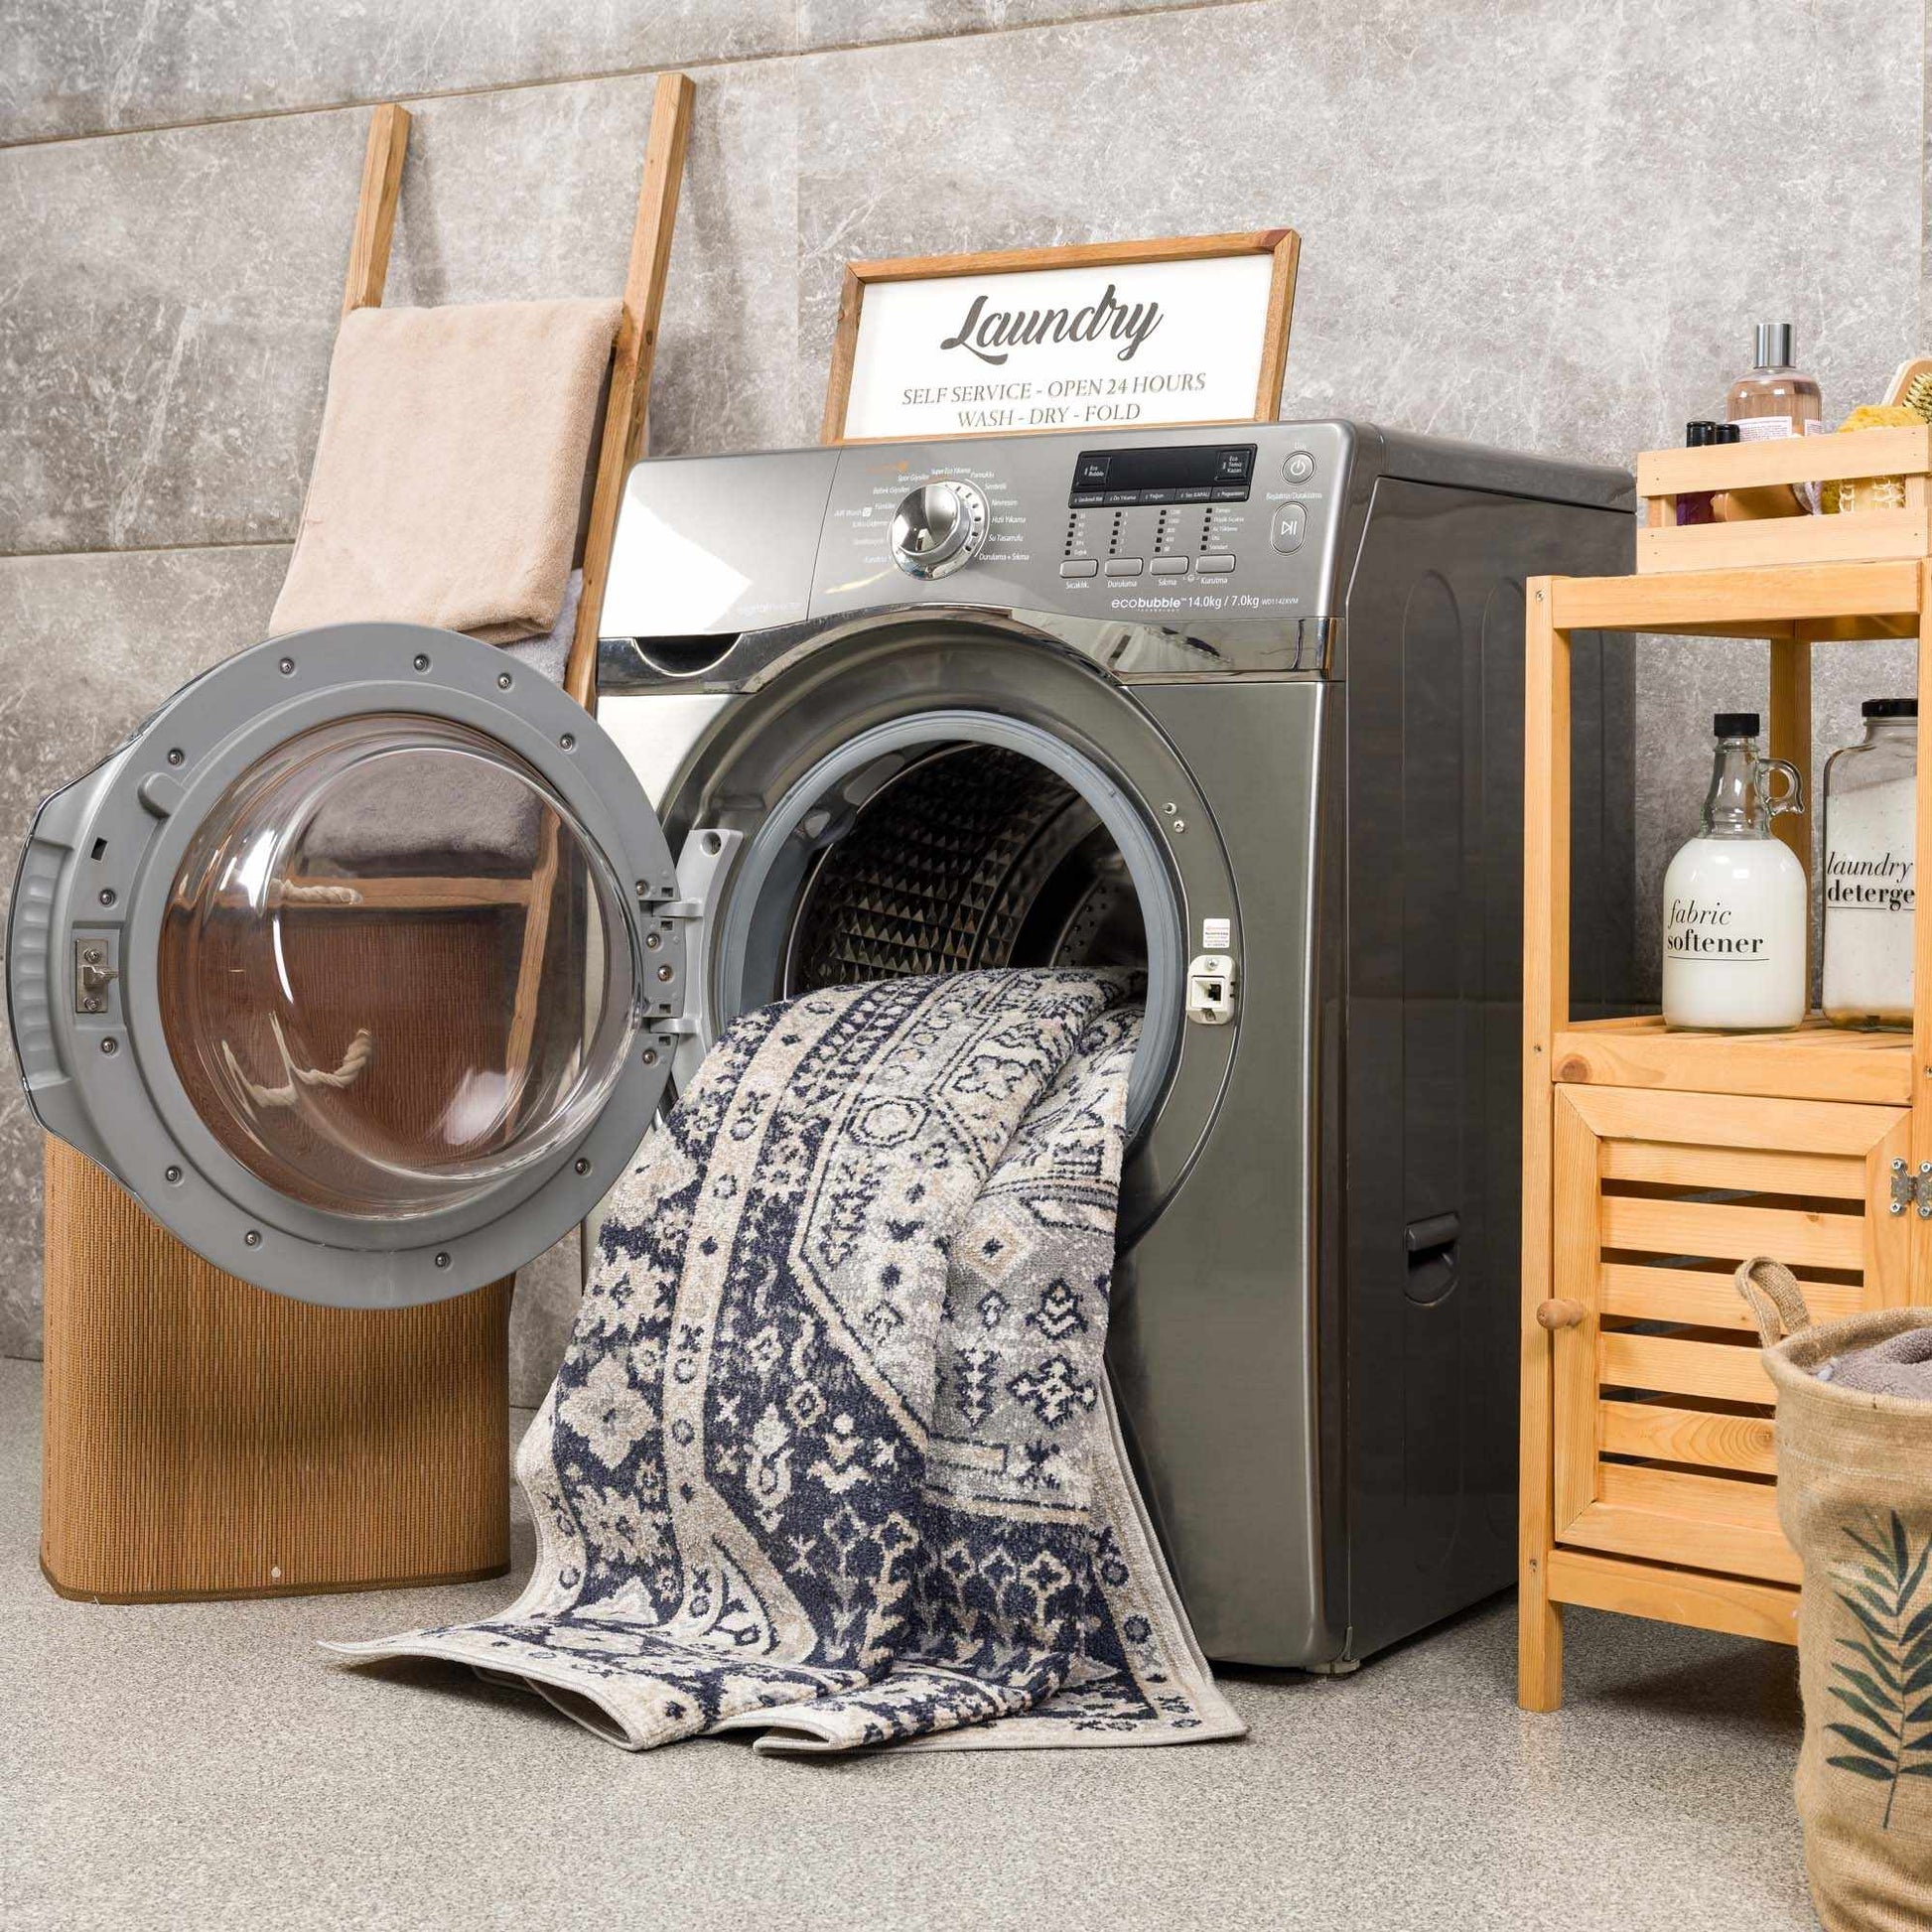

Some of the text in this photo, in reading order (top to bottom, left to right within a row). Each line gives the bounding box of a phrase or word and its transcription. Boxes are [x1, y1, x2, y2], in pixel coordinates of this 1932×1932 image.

[940, 284, 1164, 365] Laundry
[902, 387, 949, 405] SELF
[953, 382, 1032, 403] SERVICE
[1047, 378, 1102, 399] OPEN
[1106, 377, 1129, 396] 24
[1133, 372, 1206, 394] HOURS
[957, 408, 1014, 428] WASH
[1030, 406, 1070, 425] DRY
[1085, 402, 1141, 423] FOLD
[1188, 596, 1222, 610] 14.0kg
[1231, 595, 1260, 609] 7.0kg
[1827, 851, 1914, 884] laundry
[1668, 898, 1731, 929] fabric
[1667, 929, 1764, 954] softener
